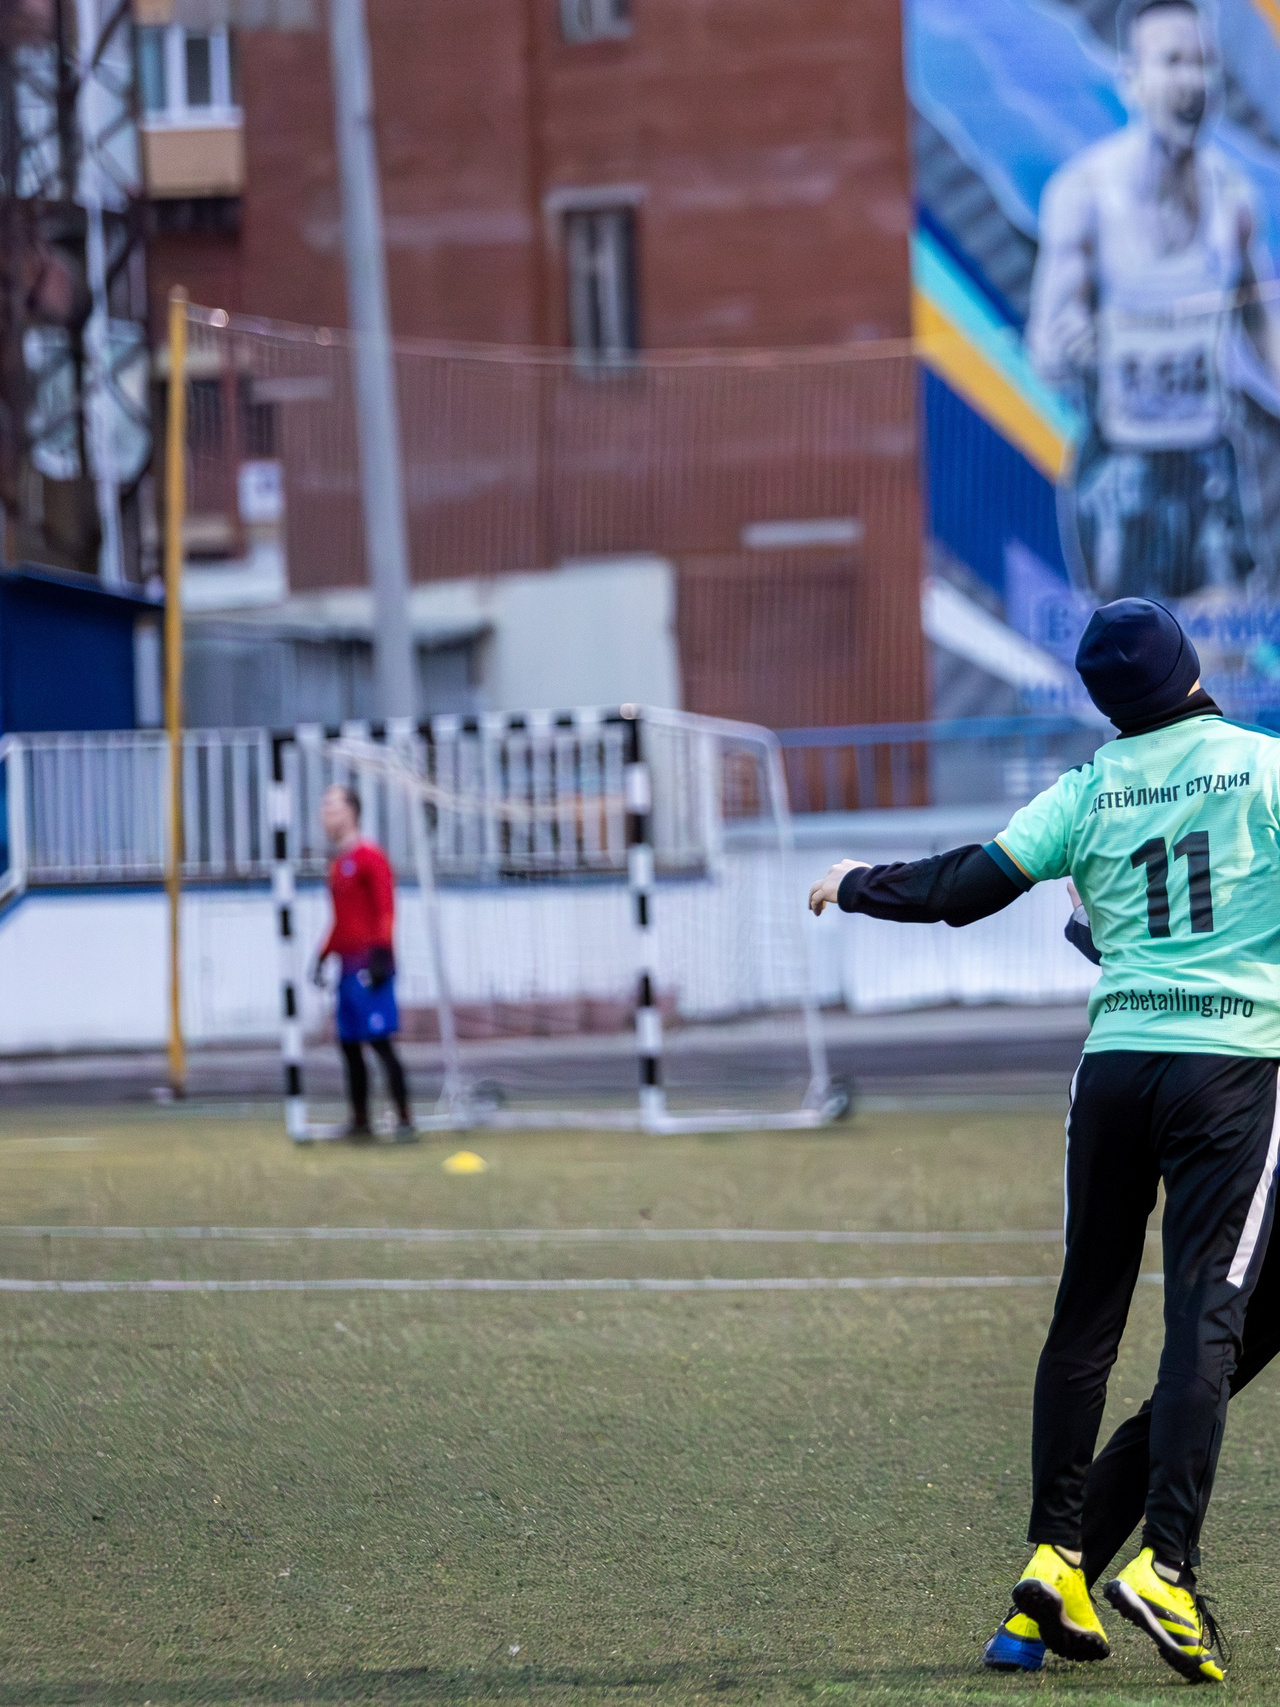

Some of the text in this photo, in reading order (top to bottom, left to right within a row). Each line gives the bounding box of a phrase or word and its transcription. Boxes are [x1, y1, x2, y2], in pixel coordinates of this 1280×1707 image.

[1089, 771, 1250, 817] ДЕТЕЙЛИНГ СТУДИЯ
[1130, 830, 1214, 938] 11
